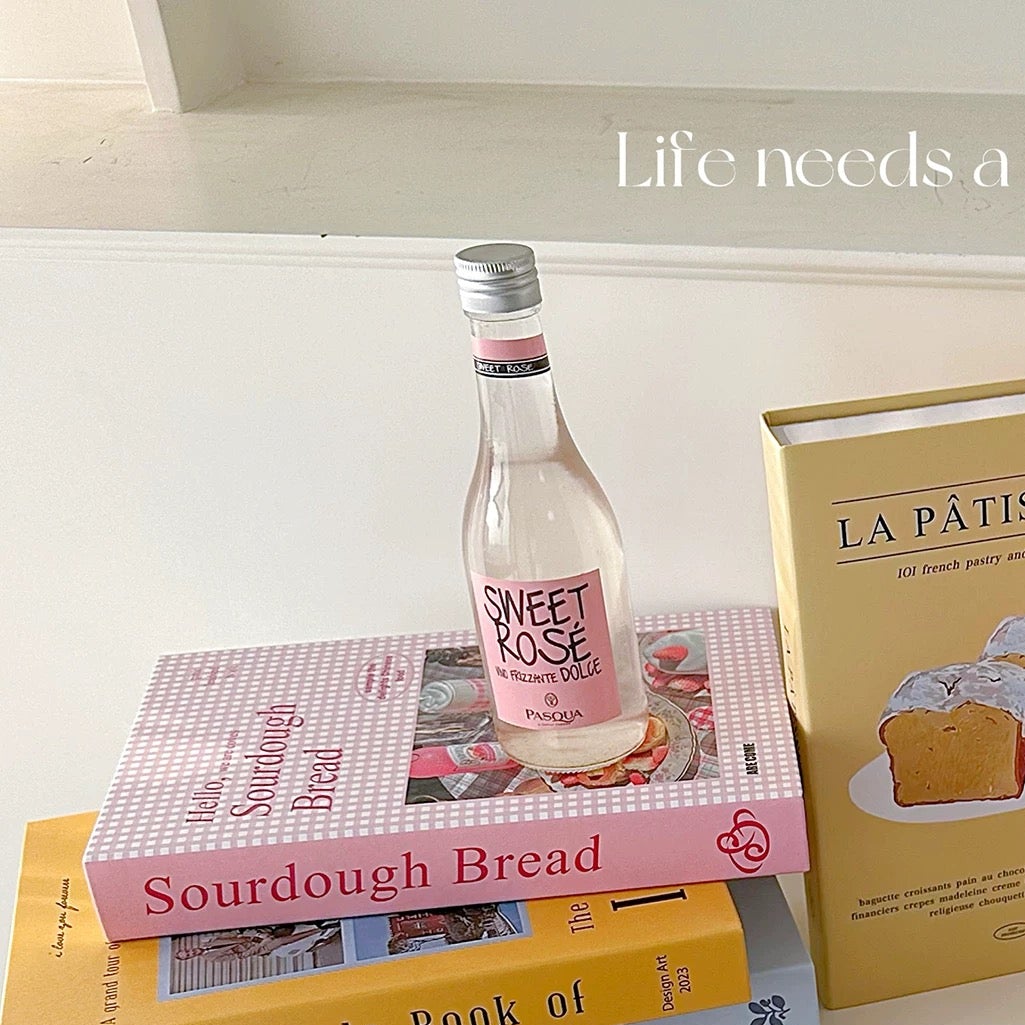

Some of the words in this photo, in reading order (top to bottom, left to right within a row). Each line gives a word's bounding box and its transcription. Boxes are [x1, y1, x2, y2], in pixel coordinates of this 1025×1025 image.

[836, 512, 897, 550] LA
[921, 558, 961, 577] french
[965, 553, 1003, 571] pastry
[483, 582, 590, 627] SWEET
[494, 621, 592, 667] ROSÉ
[559, 657, 602, 683] DOLCE
[525, 708, 584, 723] PASQUA
[229, 703, 306, 818] Sourdough
[290, 747, 344, 813] Bread
[185, 777, 233, 824] Hello,
[143, 851, 430, 917] Sourdough
[452, 833, 603, 886] Bread
[858, 892, 901, 908] baguette
[903, 882, 952, 898] croissants
[955, 876, 978, 889] pain
[981, 874, 994, 883] au
[851, 904, 900, 921] financiers
[903, 897, 936, 911] crepes
[939, 886, 989, 904] madeleine
[991, 878, 1021, 893] creme
[928, 901, 975, 918] religieuse
[567, 900, 595, 935] The
[103, 955, 122, 977] tour
[655, 953, 668, 974] Art
[675, 965, 692, 994] 2023
[101, 979, 121, 1014] grand
[546, 978, 586, 1019] of
[658, 974, 675, 1012] Design
[99, 1016, 116, 1025] A
